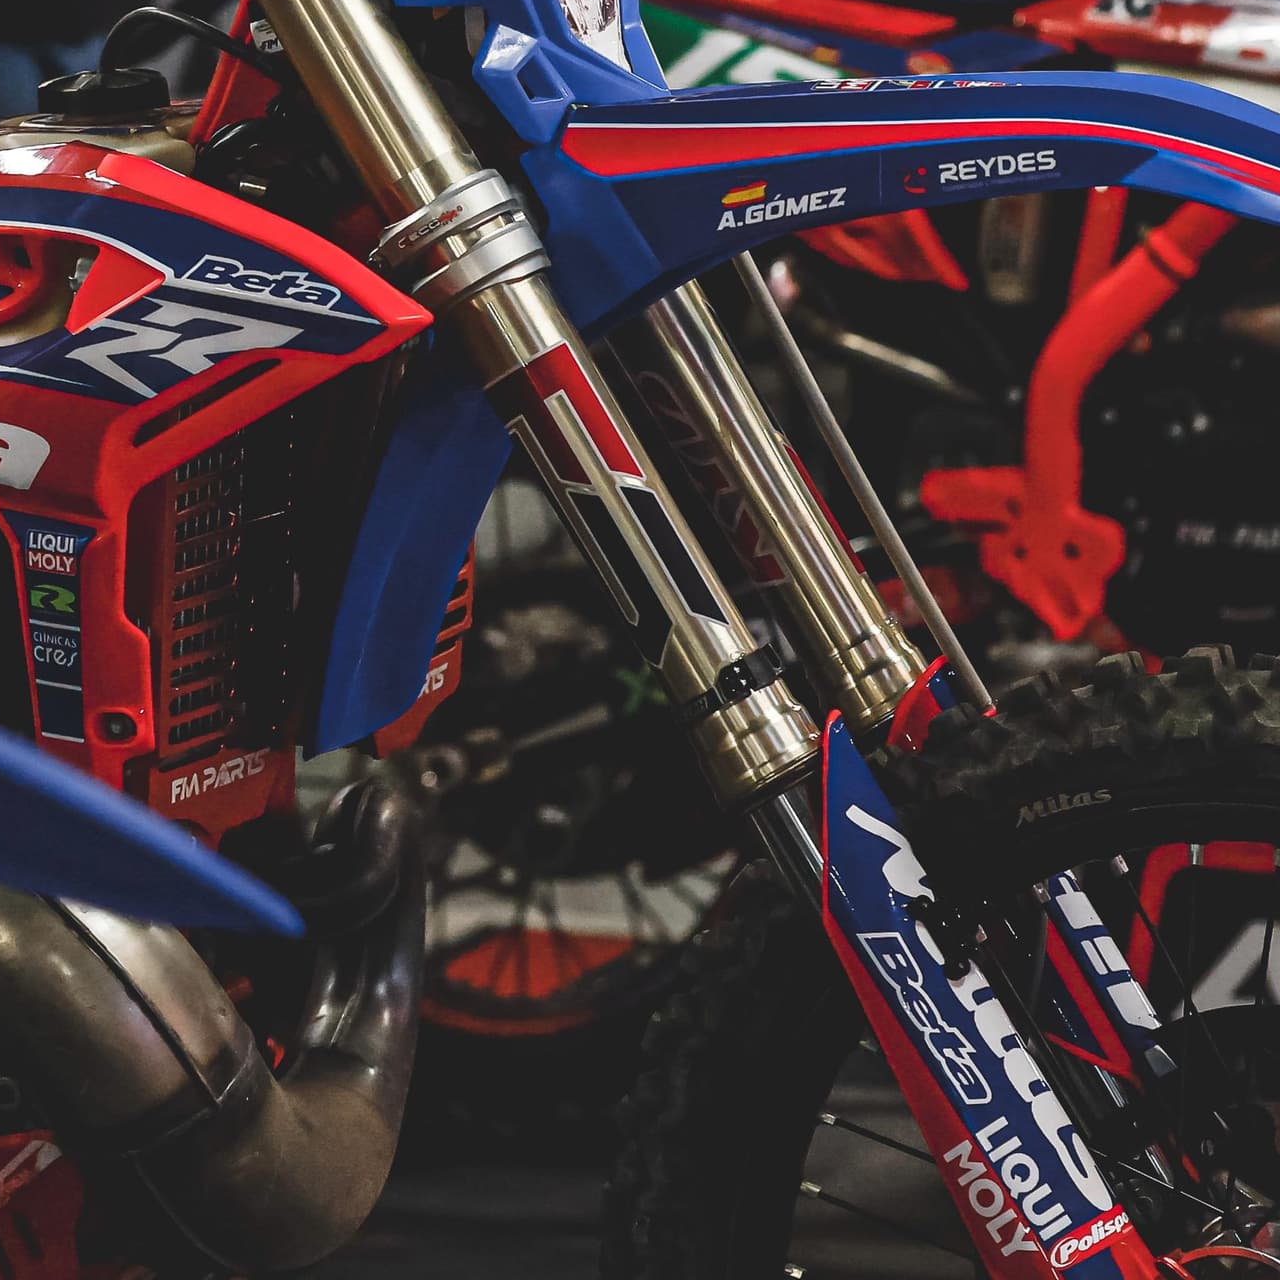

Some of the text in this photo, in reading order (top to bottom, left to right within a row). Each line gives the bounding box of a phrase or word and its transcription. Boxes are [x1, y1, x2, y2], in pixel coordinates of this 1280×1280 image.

[938, 149, 1057, 184] REYDES
[716, 186, 848, 231] A.GÓMEZ
[181, 253, 342, 312] Beta
[28, 531, 75, 554] LIQUI
[28, 551, 74, 573] MOLY
[171, 747, 270, 804] FM PARTS
[1014, 787, 1113, 829] Mitas
[855, 931, 993, 1105] Beta
[942, 1139, 1040, 1258] MOLY
[975, 1115, 1073, 1242] LIQUI
